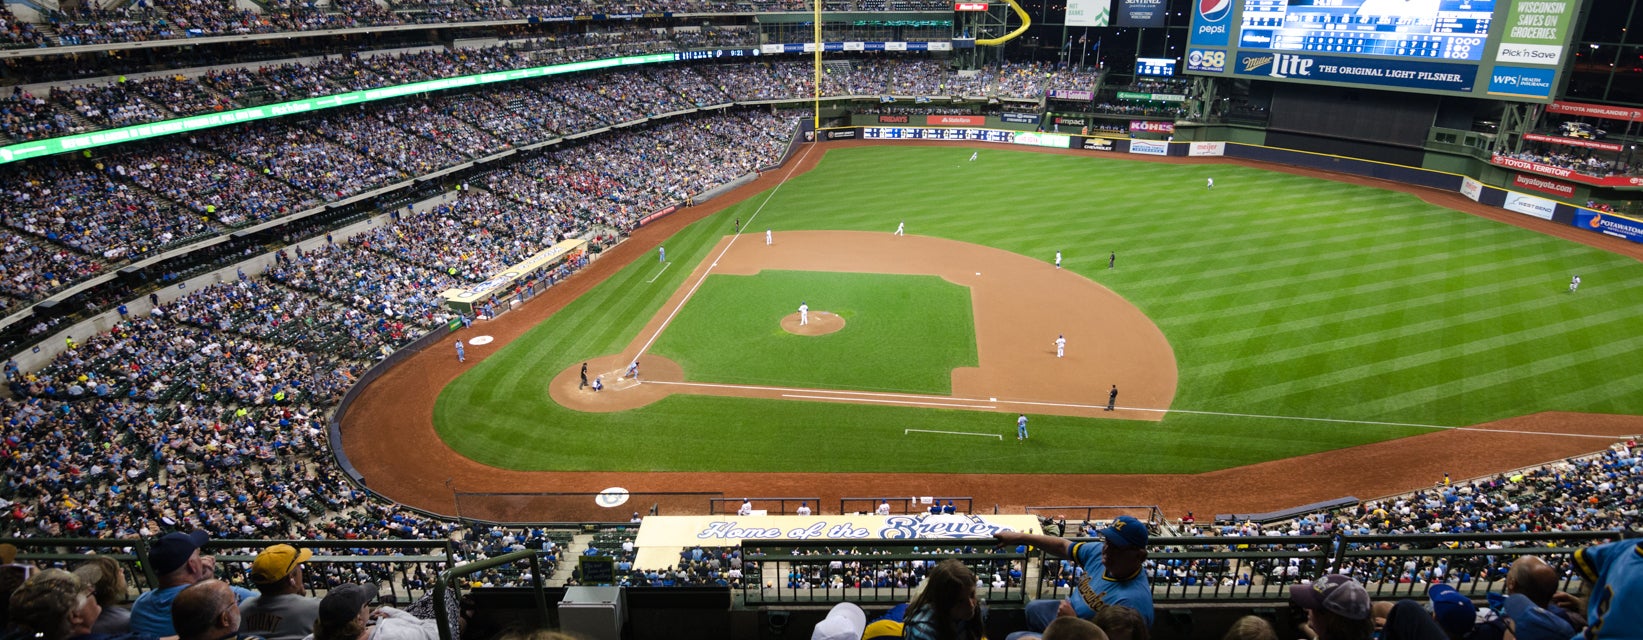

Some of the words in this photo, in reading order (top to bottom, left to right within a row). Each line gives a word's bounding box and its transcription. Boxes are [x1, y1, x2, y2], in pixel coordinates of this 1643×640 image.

[1517, 2, 1566, 14] WISCONSIN
[1517, 14, 1544, 26] SAVES
[1544, 15, 1559, 27] ON
[1199, 24, 1225, 35] pepsi
[1510, 27, 1557, 40] GROCERIES.
[1202, 51, 1225, 68] 58
[1502, 48, 1521, 57] Pick
[1531, 50, 1556, 59] Save
[1242, 56, 1273, 71] Miller
[1269, 52, 1314, 78] Lite
[1318, 65, 1338, 74] THE
[1339, 66, 1383, 77] ORIGINAL
[1385, 69, 1416, 79] LIGHT
[1417, 72, 1463, 82] PILSNER.
[1493, 75, 1517, 85] WPS
[1586, 108, 1629, 117] HIGHLANDER
[1060, 118, 1084, 126] impact
[1131, 121, 1174, 132] KOHL'S
[1504, 158, 1531, 170] TOYOTA
[1532, 162, 1571, 177] TERRITORY
[1517, 175, 1573, 194] buyatoyota.com
[1518, 201, 1535, 209] WEST
[1535, 204, 1552, 213] BEND
[697, 521, 781, 539] Home
[787, 521, 826, 540] of
[827, 522, 869, 539] the
